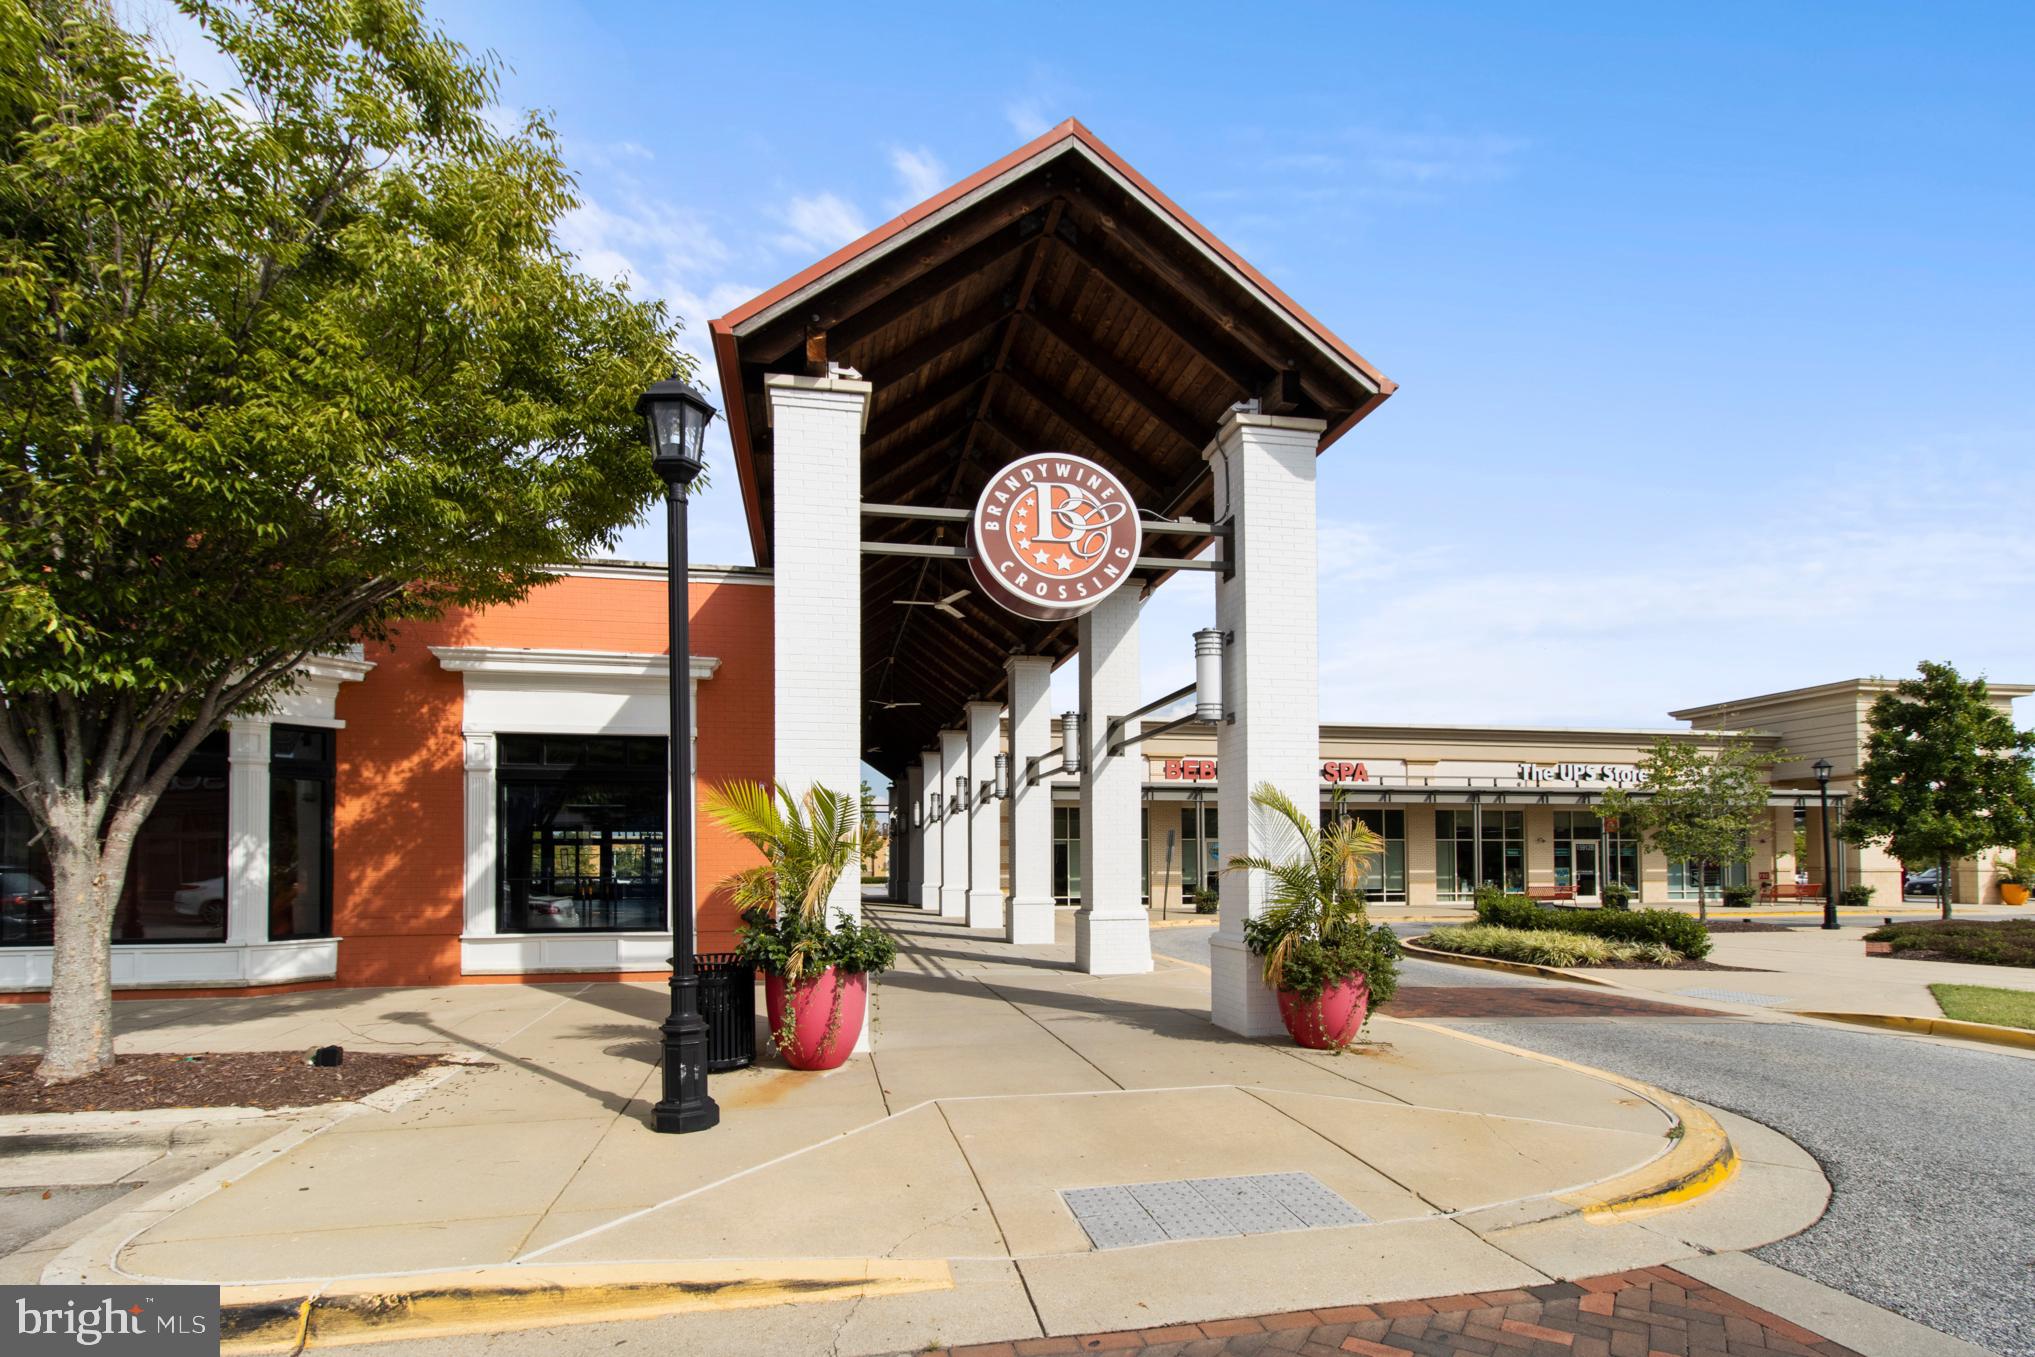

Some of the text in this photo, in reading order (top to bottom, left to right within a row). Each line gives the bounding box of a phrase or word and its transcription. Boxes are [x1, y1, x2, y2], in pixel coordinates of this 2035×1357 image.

[985, 463, 1115, 531] BRANDYWINE
[1000, 547, 1130, 599] CROSSING
[1323, 761, 1369, 782] SPA
[1518, 763, 1650, 782] The UPS Store
